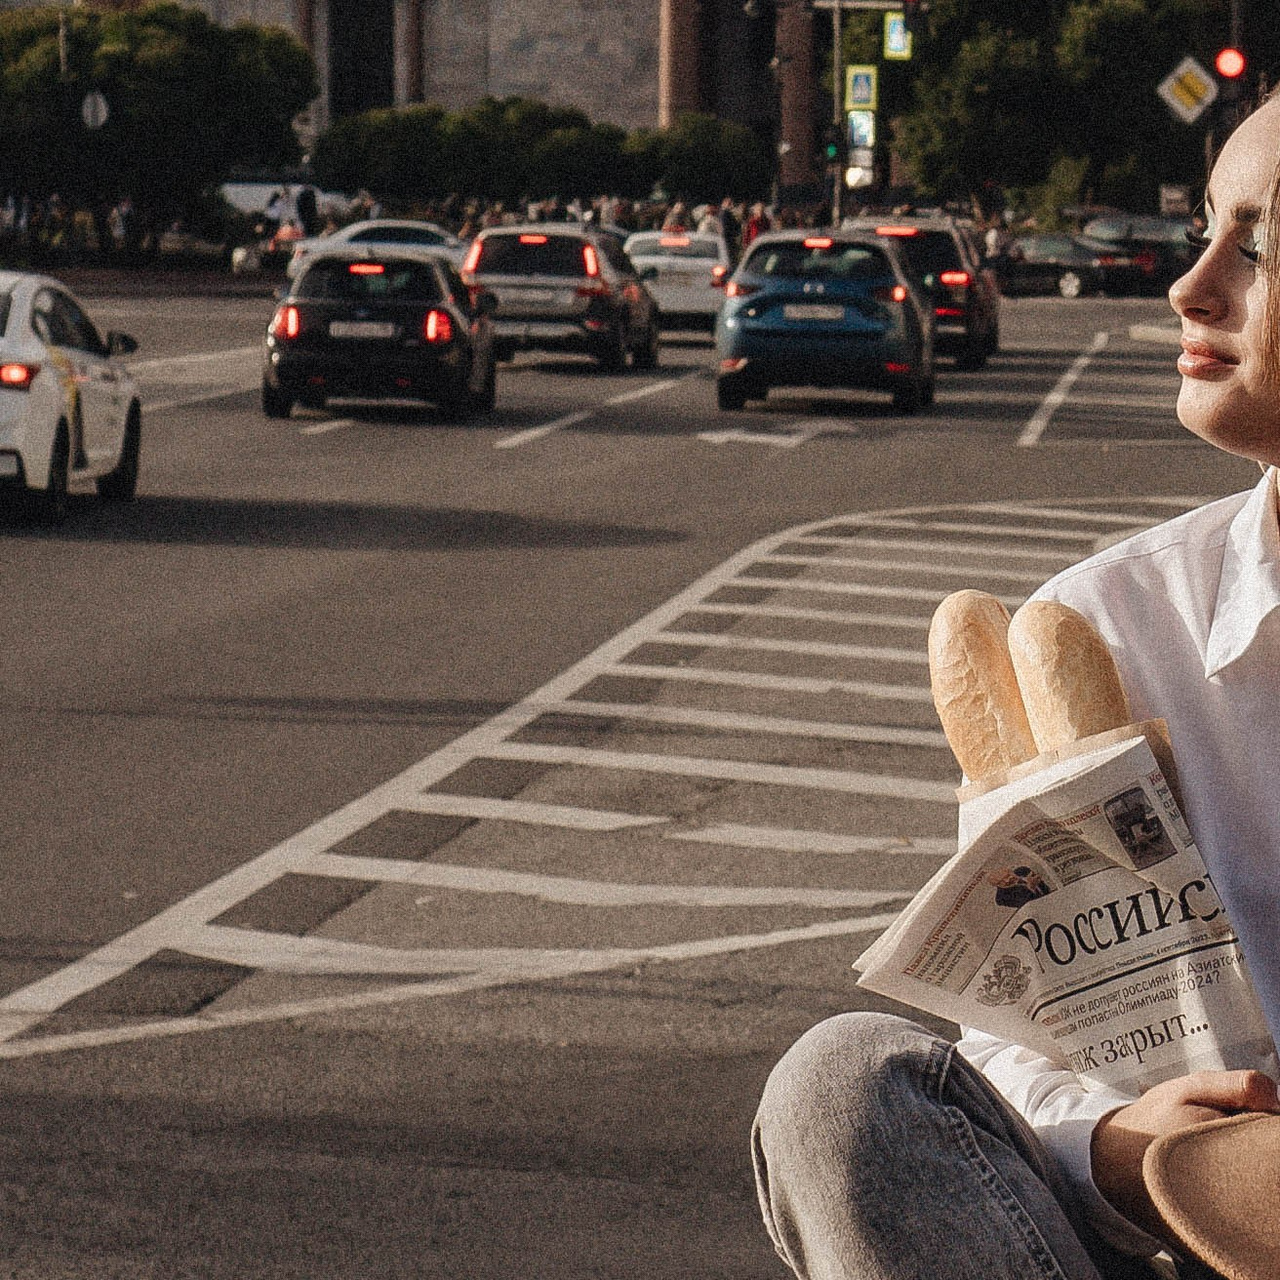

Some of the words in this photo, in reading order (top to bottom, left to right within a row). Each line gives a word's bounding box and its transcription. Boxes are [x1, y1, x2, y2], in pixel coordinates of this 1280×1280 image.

[1011, 873, 1227, 974] Российс
[1122, 974, 1170, 998] россиян
[1171, 968, 1185, 980] на
